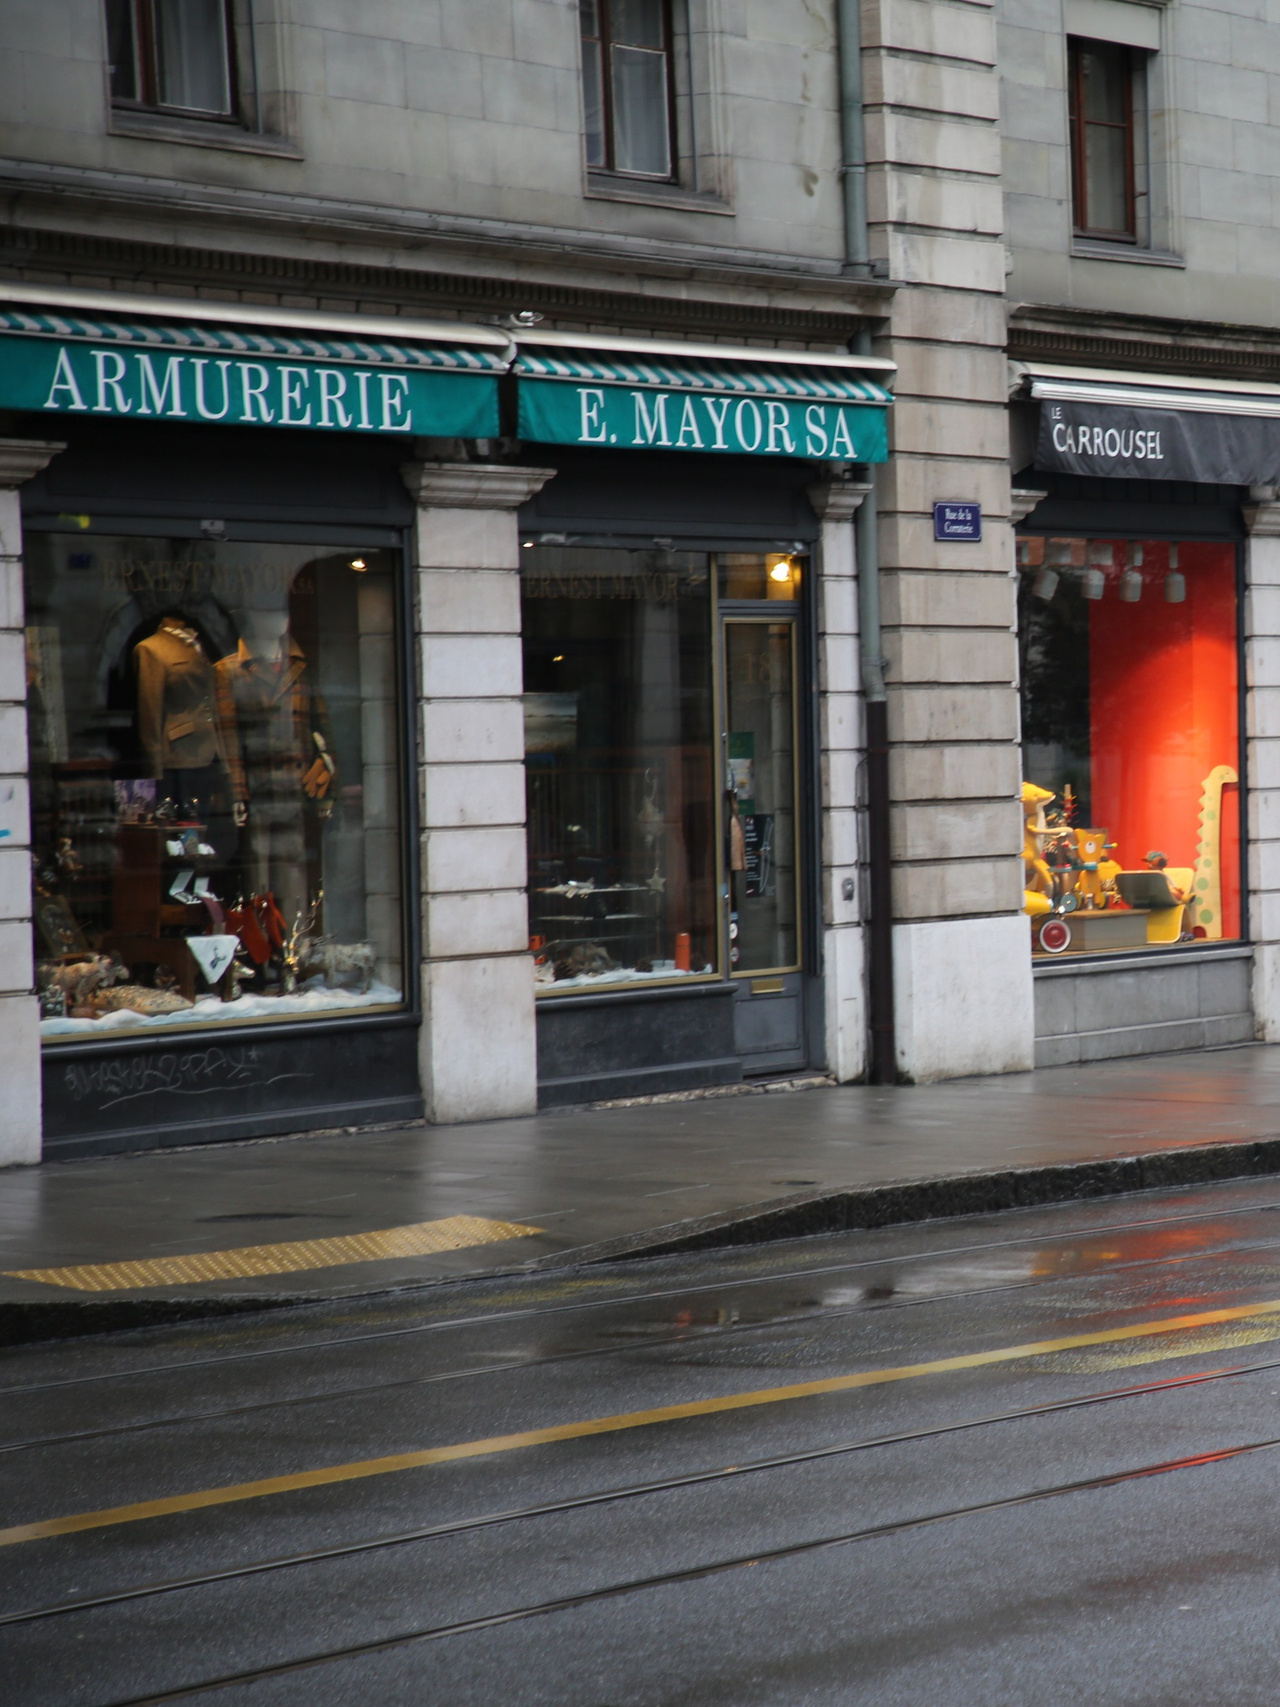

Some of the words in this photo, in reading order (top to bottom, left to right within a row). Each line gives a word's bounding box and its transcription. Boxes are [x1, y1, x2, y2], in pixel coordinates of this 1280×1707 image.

[43, 346, 412, 432] ARMURERIE
[1051, 406, 1062, 419] LE
[576, 388, 617, 444] E.
[630, 391, 796, 453] MAYOR
[804, 405, 858, 459] SA
[1052, 422, 1164, 460] CARROUSEL
